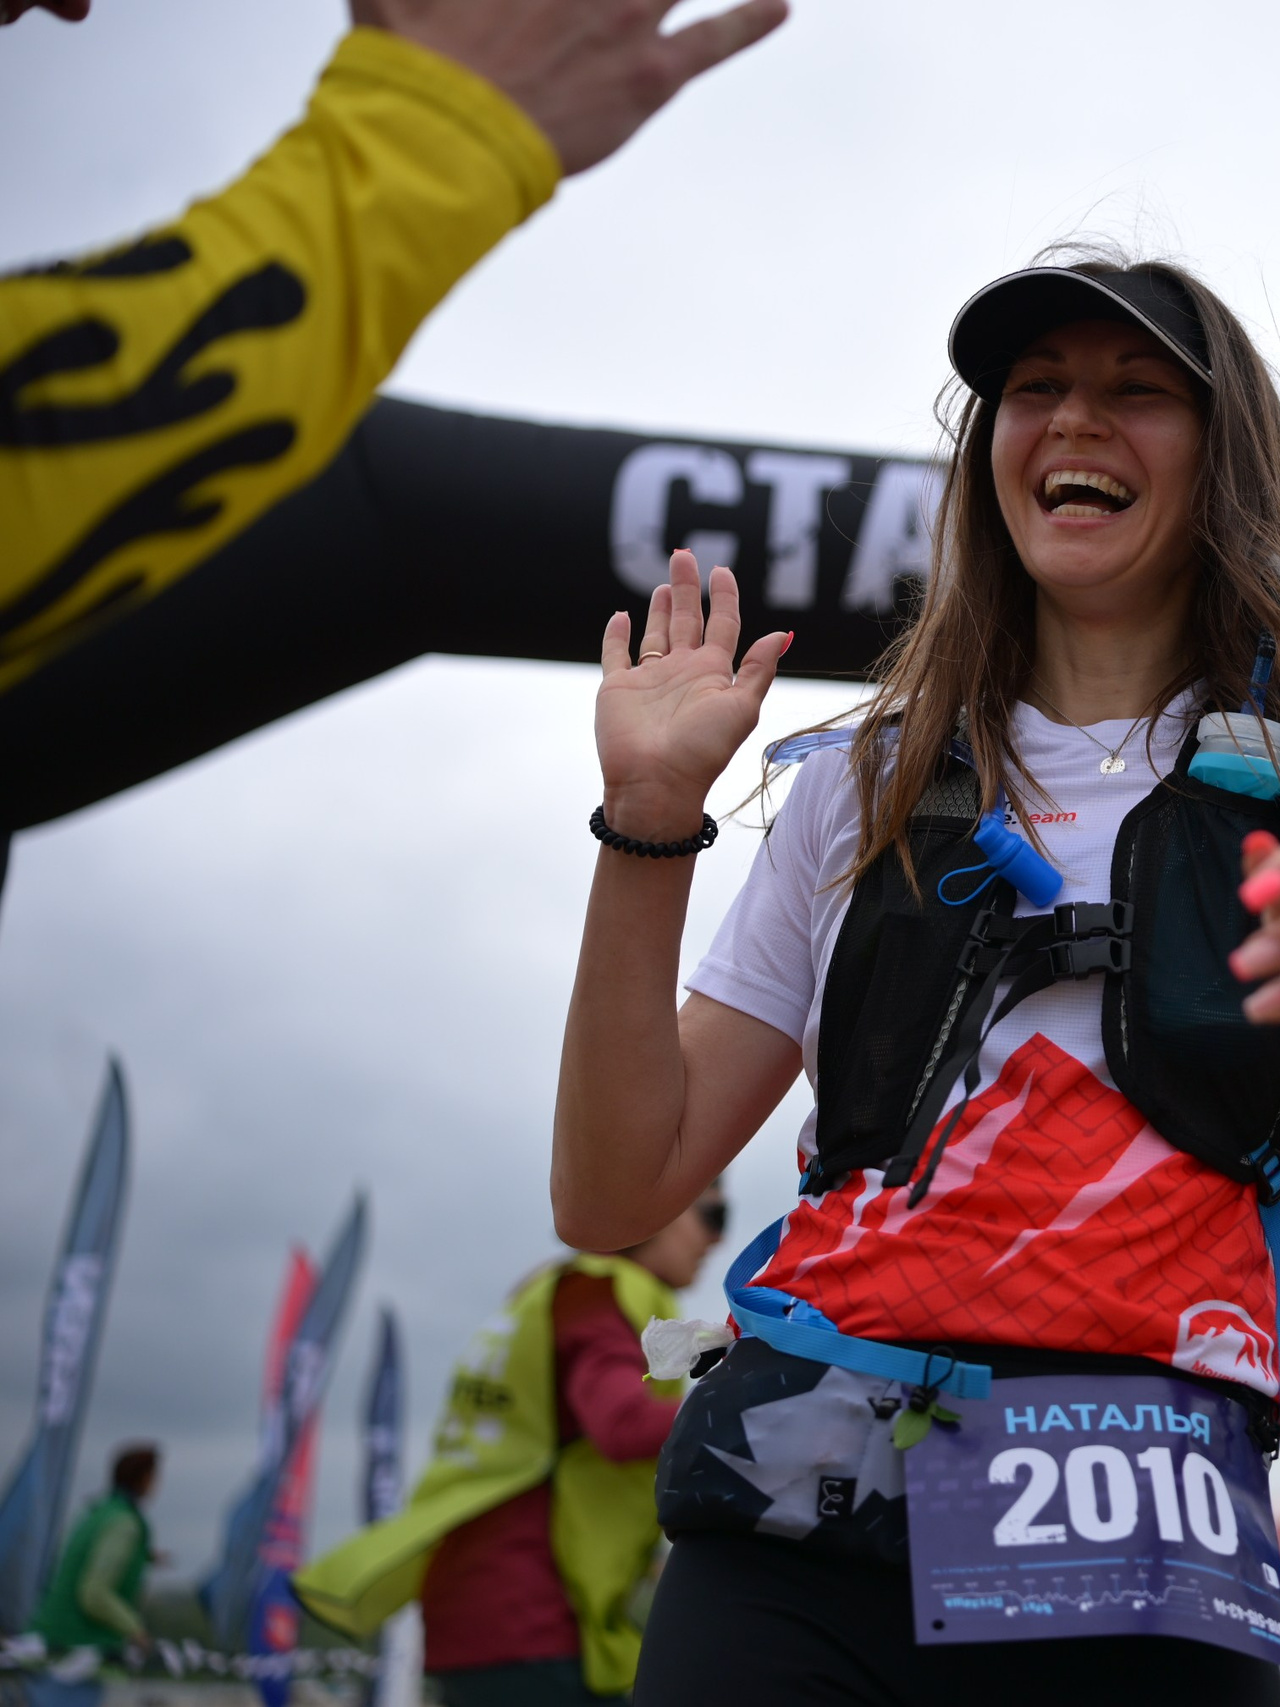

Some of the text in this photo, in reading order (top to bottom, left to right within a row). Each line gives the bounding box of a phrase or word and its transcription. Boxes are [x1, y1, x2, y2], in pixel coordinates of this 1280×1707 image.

[610, 443, 947, 611] СТА
[1004, 1403, 1210, 1445] НАТАЛЬЯ
[987, 1445, 1239, 1556] 2010
